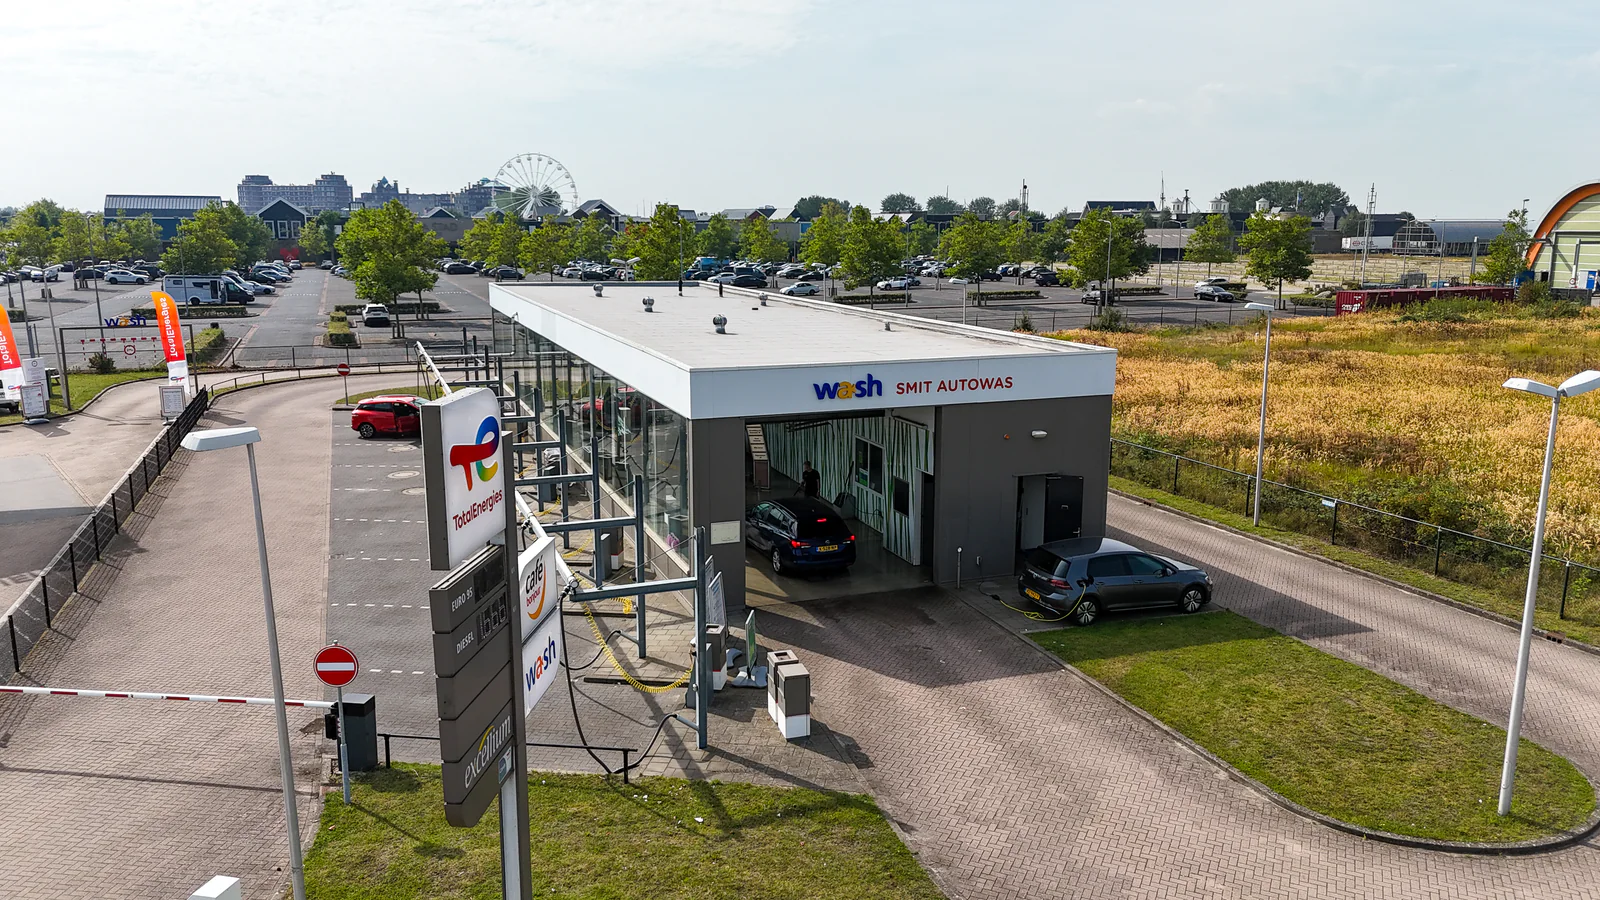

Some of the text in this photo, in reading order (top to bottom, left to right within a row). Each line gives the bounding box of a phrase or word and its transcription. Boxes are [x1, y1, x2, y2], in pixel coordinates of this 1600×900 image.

[104, 314, 147, 327] wash
[812, 373, 1013, 400] wash SMIT AUTOWAS
[452, 489, 503, 531] TotalEnergies
[525, 554, 544, 594] café
[451, 586, 474, 612] EURO 95
[456, 631, 475, 654] DIESEL
[525, 635, 556, 692] wash
[464, 715, 511, 789] excellium
